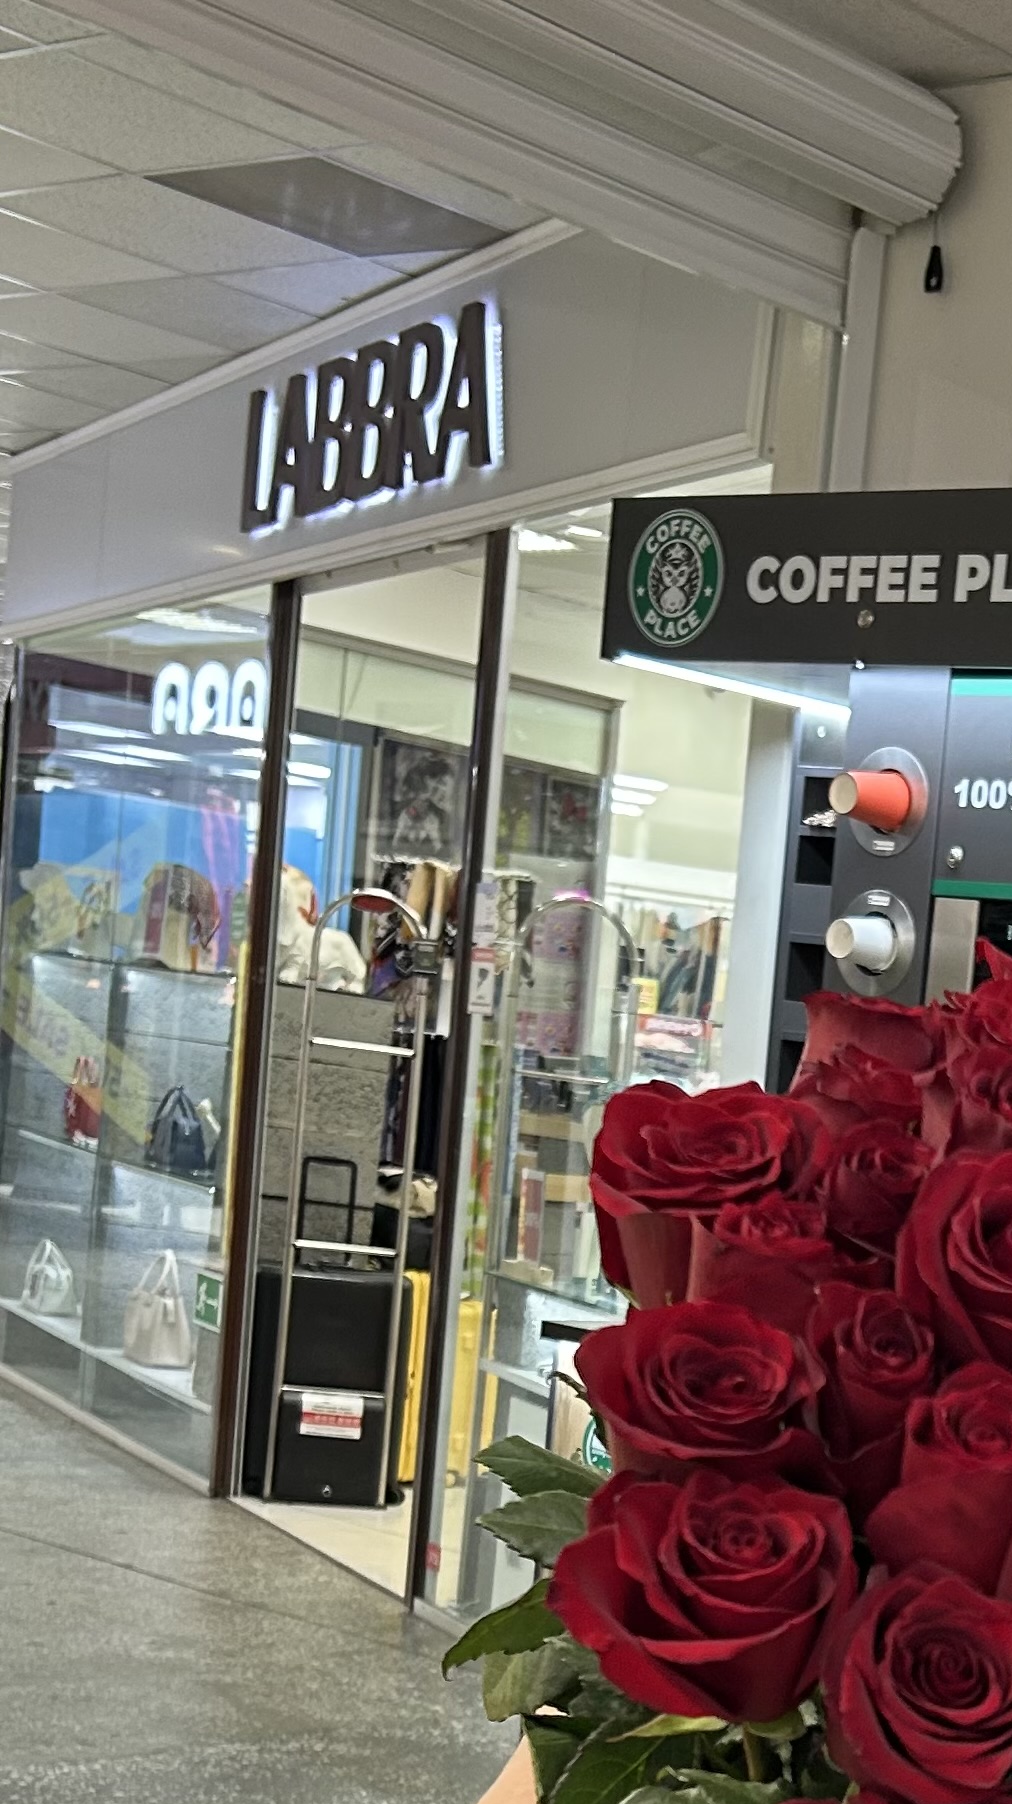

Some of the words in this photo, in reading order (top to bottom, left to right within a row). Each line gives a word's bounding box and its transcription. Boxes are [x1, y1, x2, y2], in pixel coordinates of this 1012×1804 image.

[242, 302, 491, 533] LABBRA
[646, 519, 712, 553] COFFEE
[746, 555, 941, 603] COFFEE
[644, 609, 700, 638] PLACE
